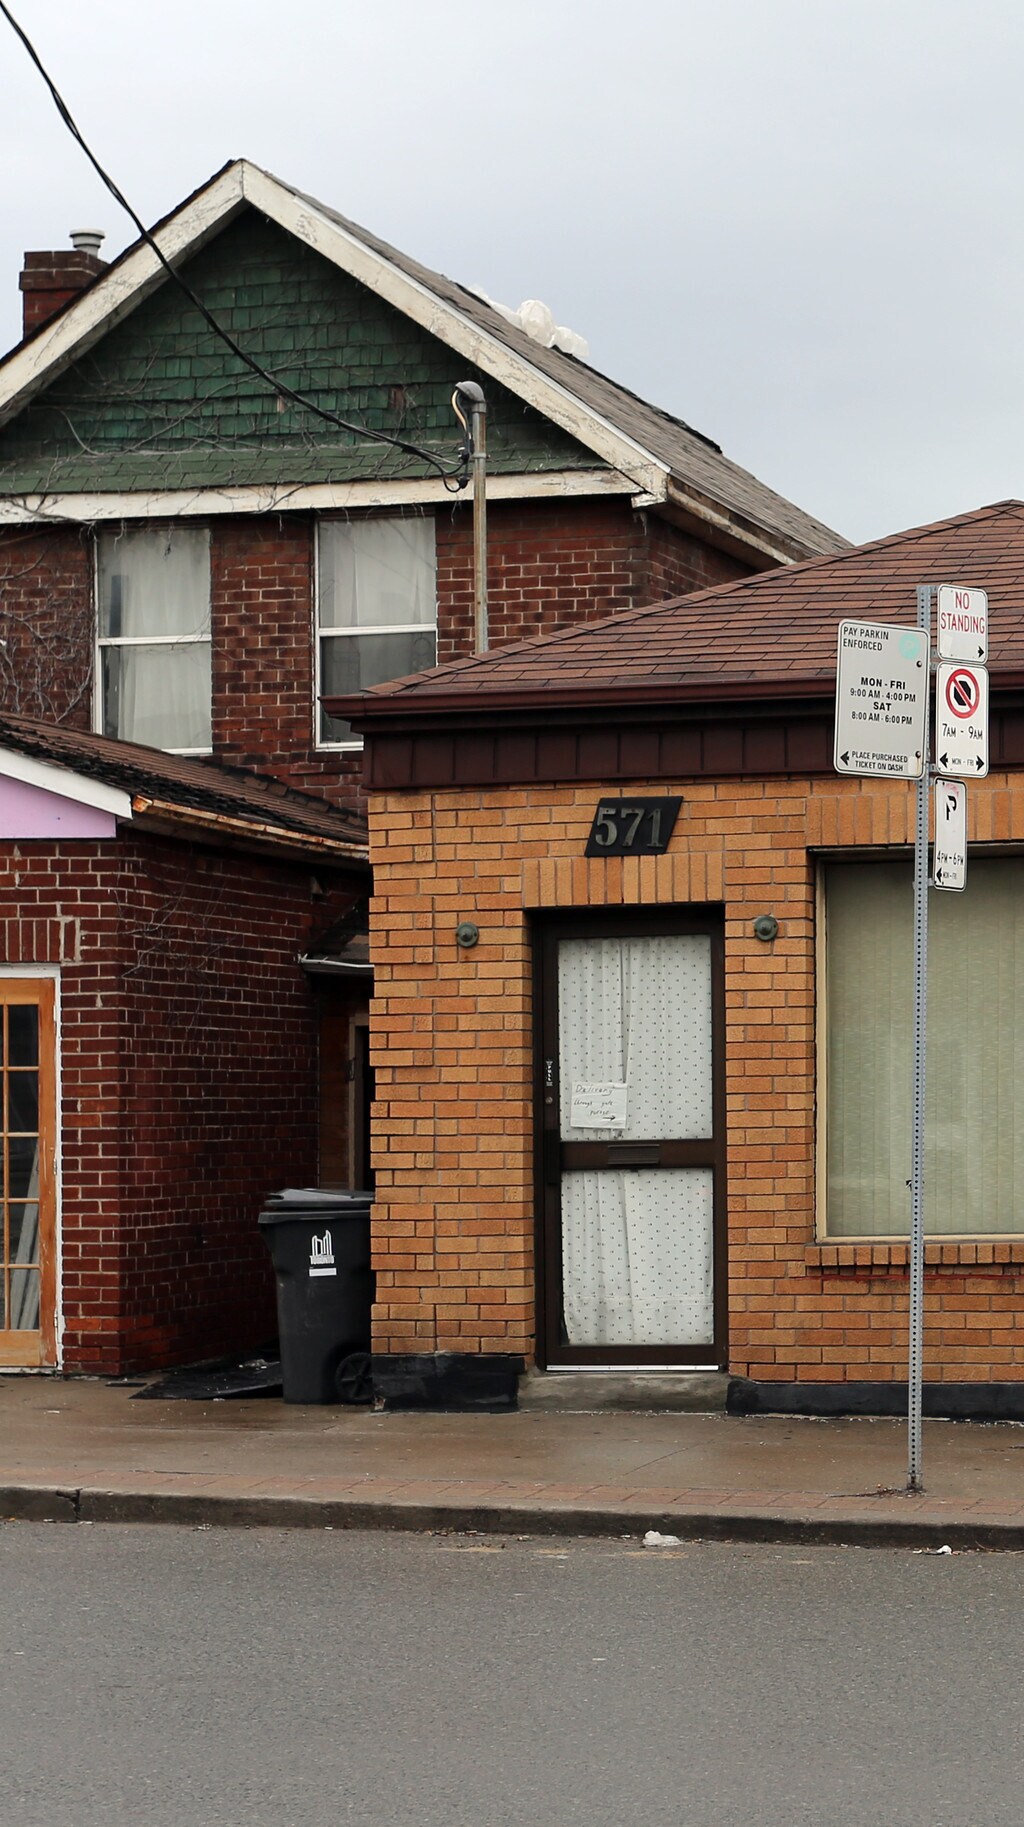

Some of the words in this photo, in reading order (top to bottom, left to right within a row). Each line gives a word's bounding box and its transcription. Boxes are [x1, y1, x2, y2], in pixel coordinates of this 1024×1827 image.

[955, 592, 970, 610] NO
[941, 612, 985, 634] STANDING
[843, 627, 858, 636] PAY
[843, 638, 883, 651] ENFORCED
[861, 677, 882, 687] MON
[890, 680, 906, 690] FRI
[850, 688, 867, 697] 9:00
[868, 690, 881, 699] AM
[886, 692, 903, 701] 4:00
[904, 693, 916, 702] PM
[873, 701, 892, 711] SAT
[851, 711, 868, 720] 8:00
[869, 713, 880, 721] AM
[885, 715, 901, 724] 6:00
[902, 716, 913, 725] PM
[942, 723, 957, 738] 7AM
[968, 726, 983, 740] 9AM
[852, 750, 871, 760] PLACE
[872, 753, 909, 763] PURCHASED
[855, 760, 876, 769] TICKET
[877, 762, 887, 770] ON
[888, 763, 904, 771] DASH
[595, 806, 664, 848] 571
